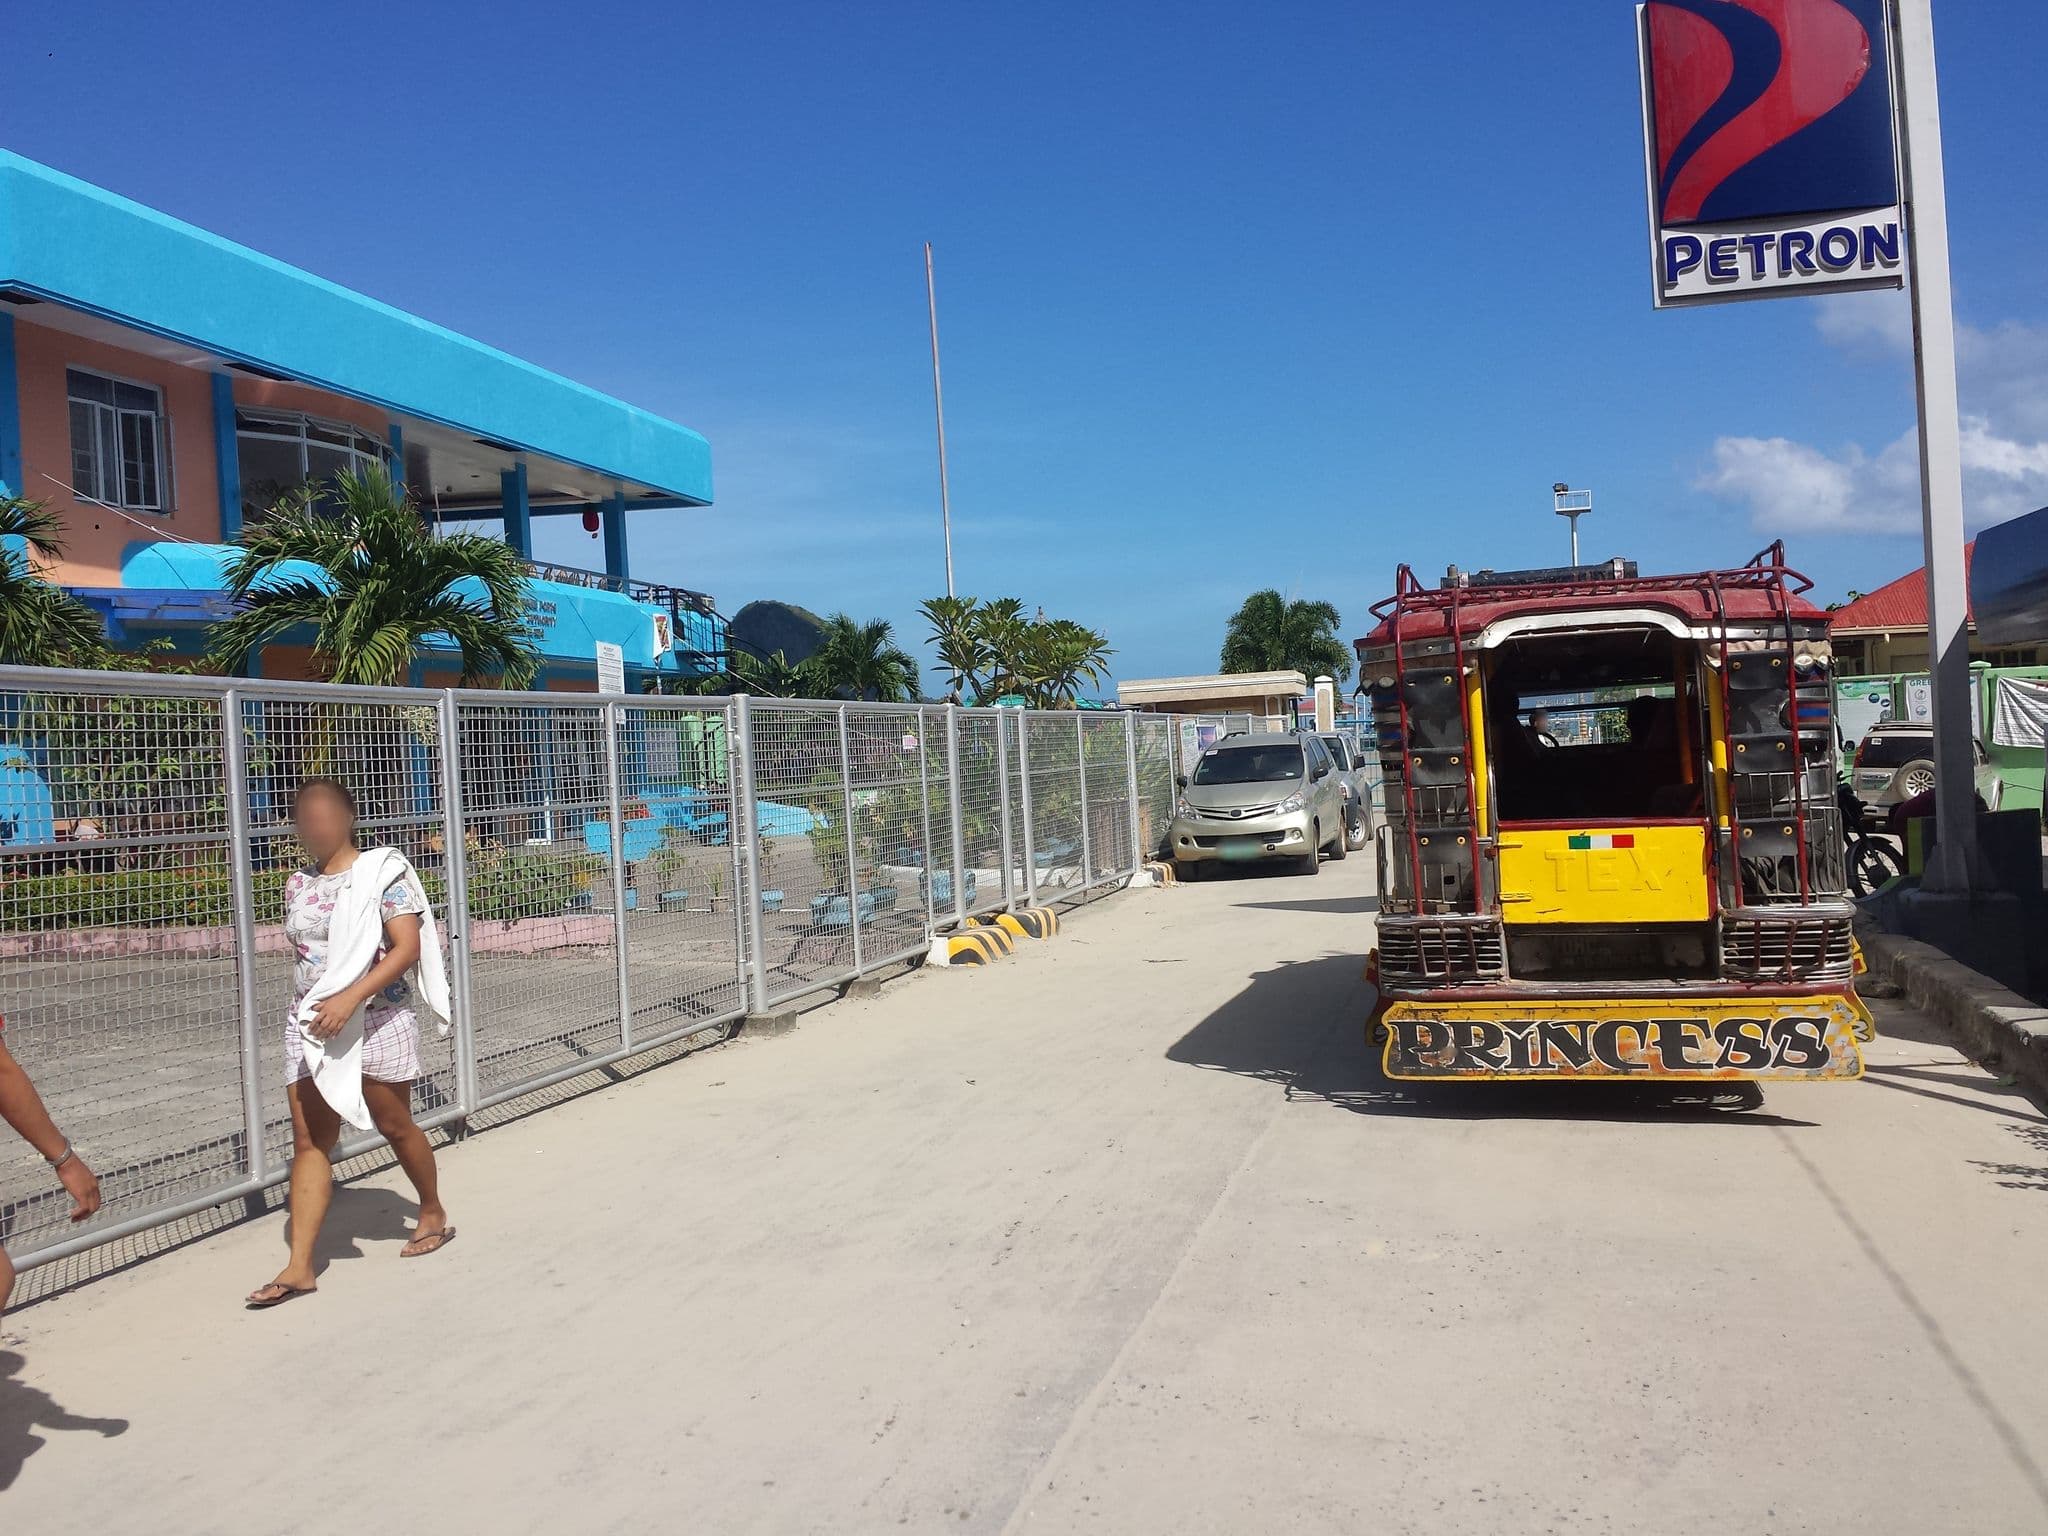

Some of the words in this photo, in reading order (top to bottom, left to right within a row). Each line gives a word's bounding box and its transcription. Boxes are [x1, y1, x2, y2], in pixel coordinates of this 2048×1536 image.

[1664, 222, 1900, 287] PETRON
[1544, 848, 1662, 892] TEX
[1385, 1016, 1833, 1072] PRINCESS
